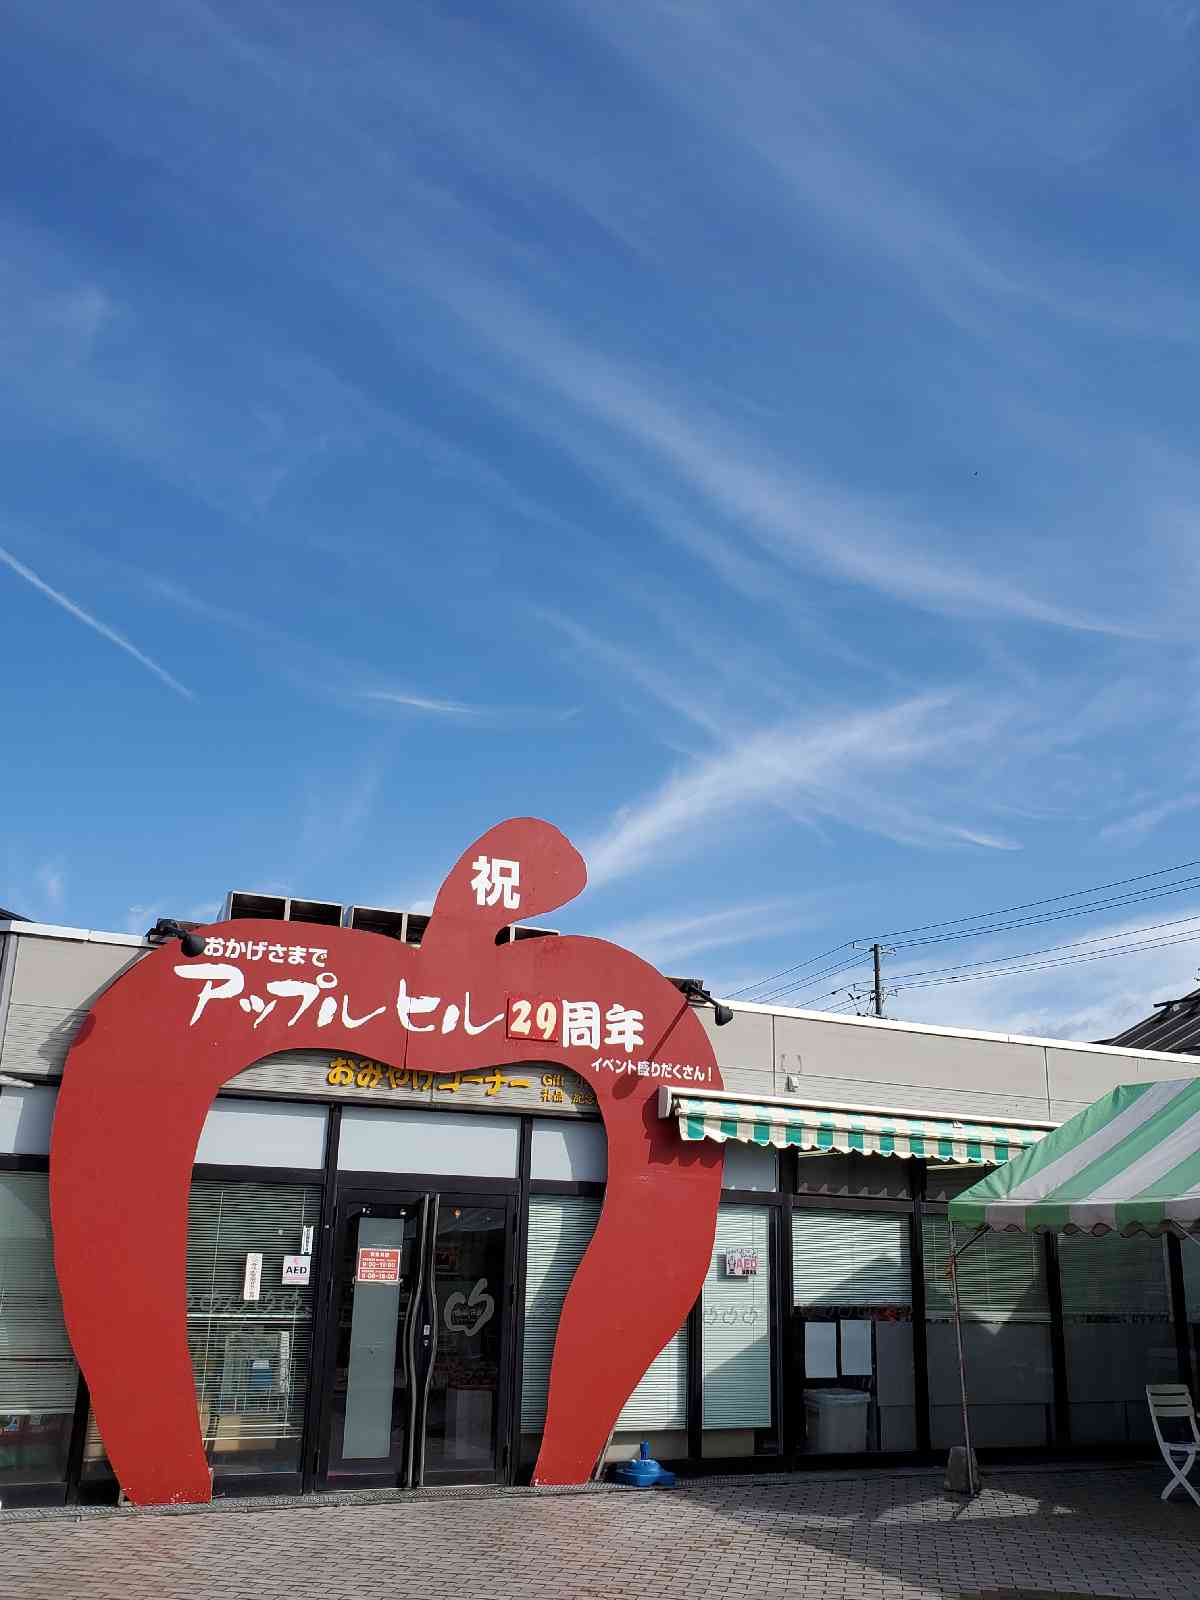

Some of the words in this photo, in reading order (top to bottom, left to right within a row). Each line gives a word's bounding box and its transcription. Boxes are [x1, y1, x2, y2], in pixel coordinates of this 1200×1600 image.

[470, 855, 521, 910] 祝
[204, 936, 328, 968] おかげさまで
[286, 1266, 307, 1275] AED
[736, 1258, 758, 1270] AED
